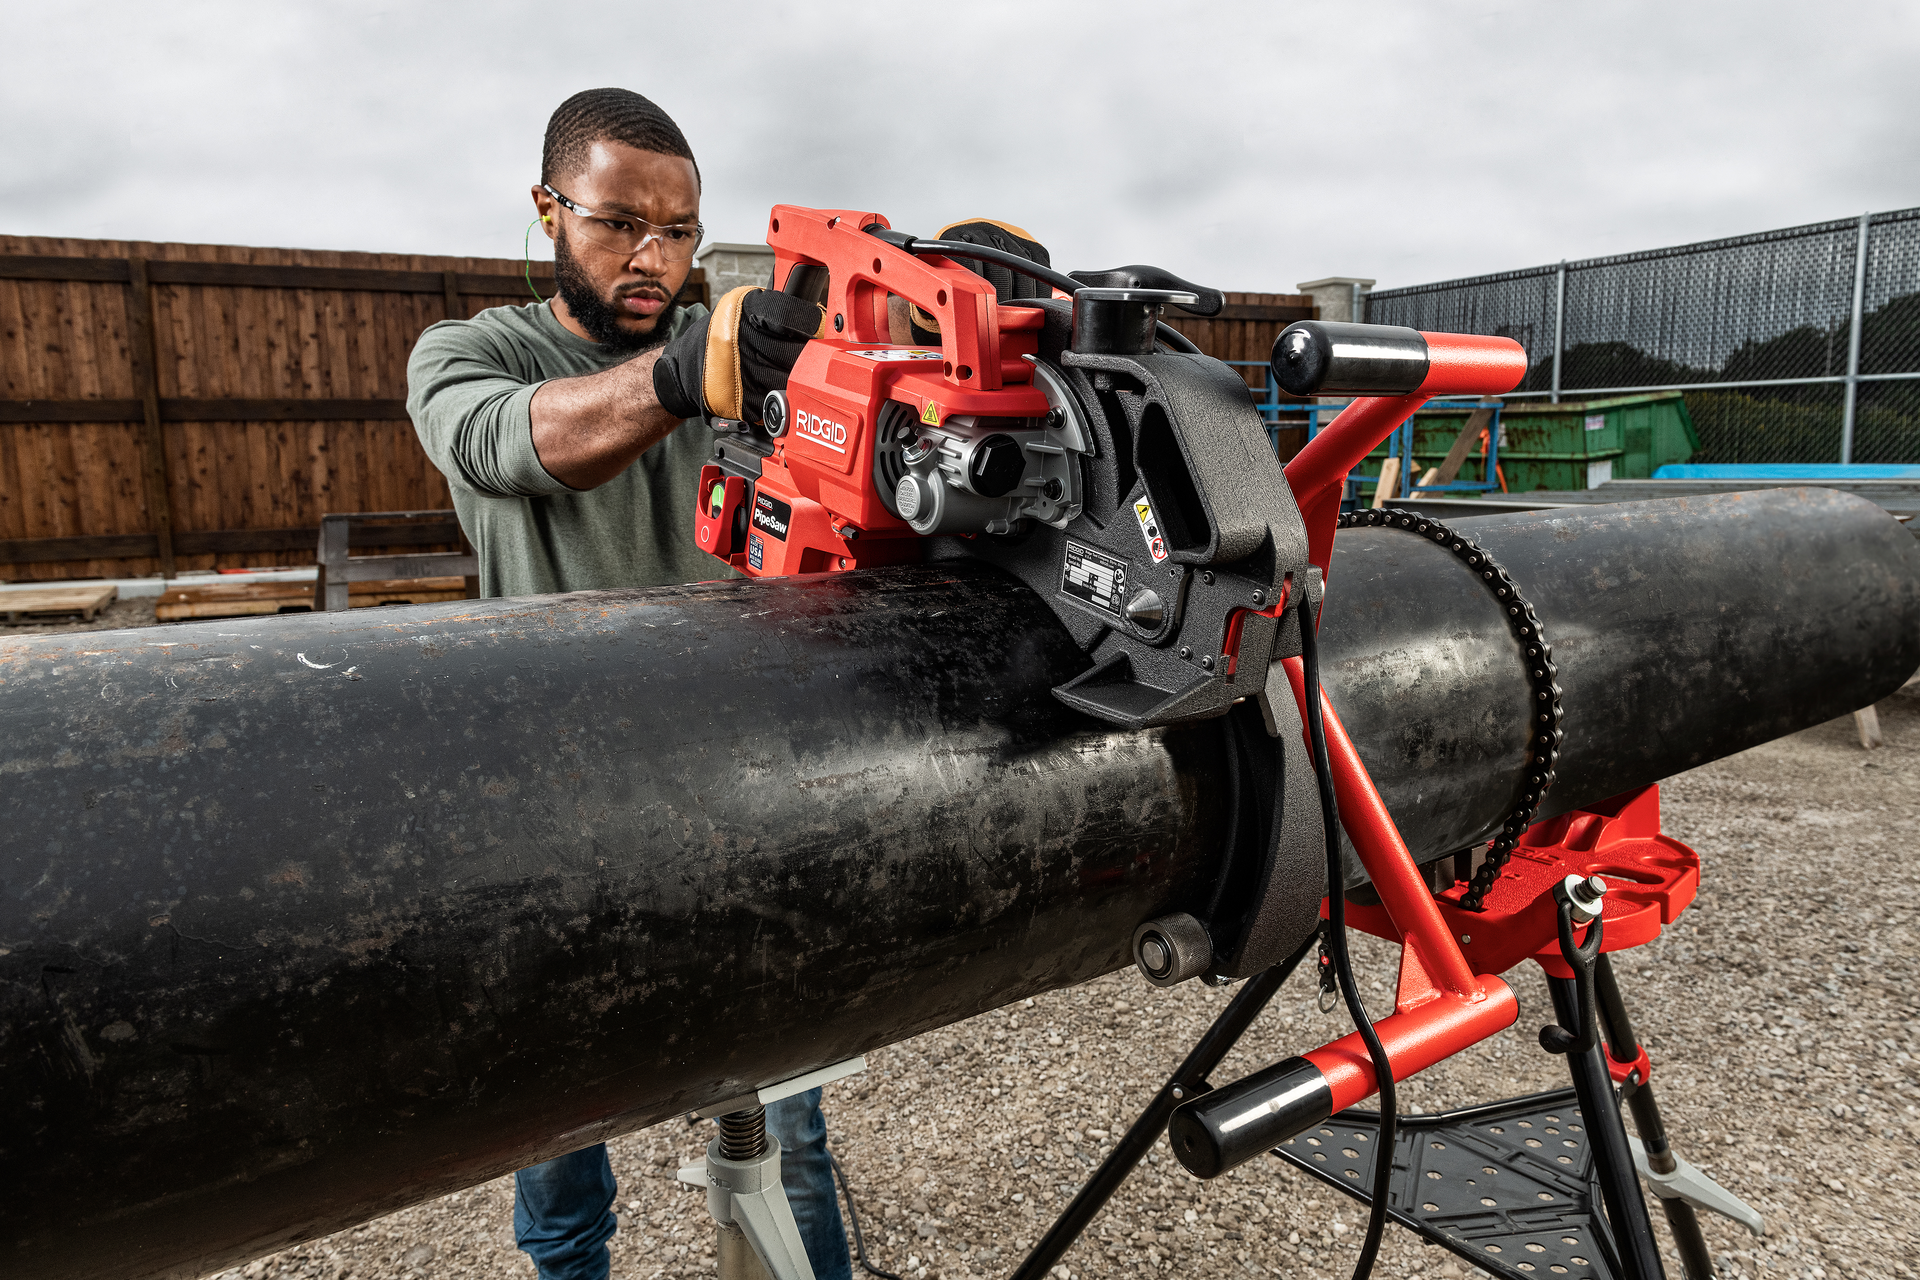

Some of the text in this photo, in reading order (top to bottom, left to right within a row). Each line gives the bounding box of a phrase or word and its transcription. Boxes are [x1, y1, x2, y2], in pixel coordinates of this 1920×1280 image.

[796, 409, 848, 445] RIDGID
[754, 507, 787, 534] PipeSaw
[750, 545, 762, 558] USA
